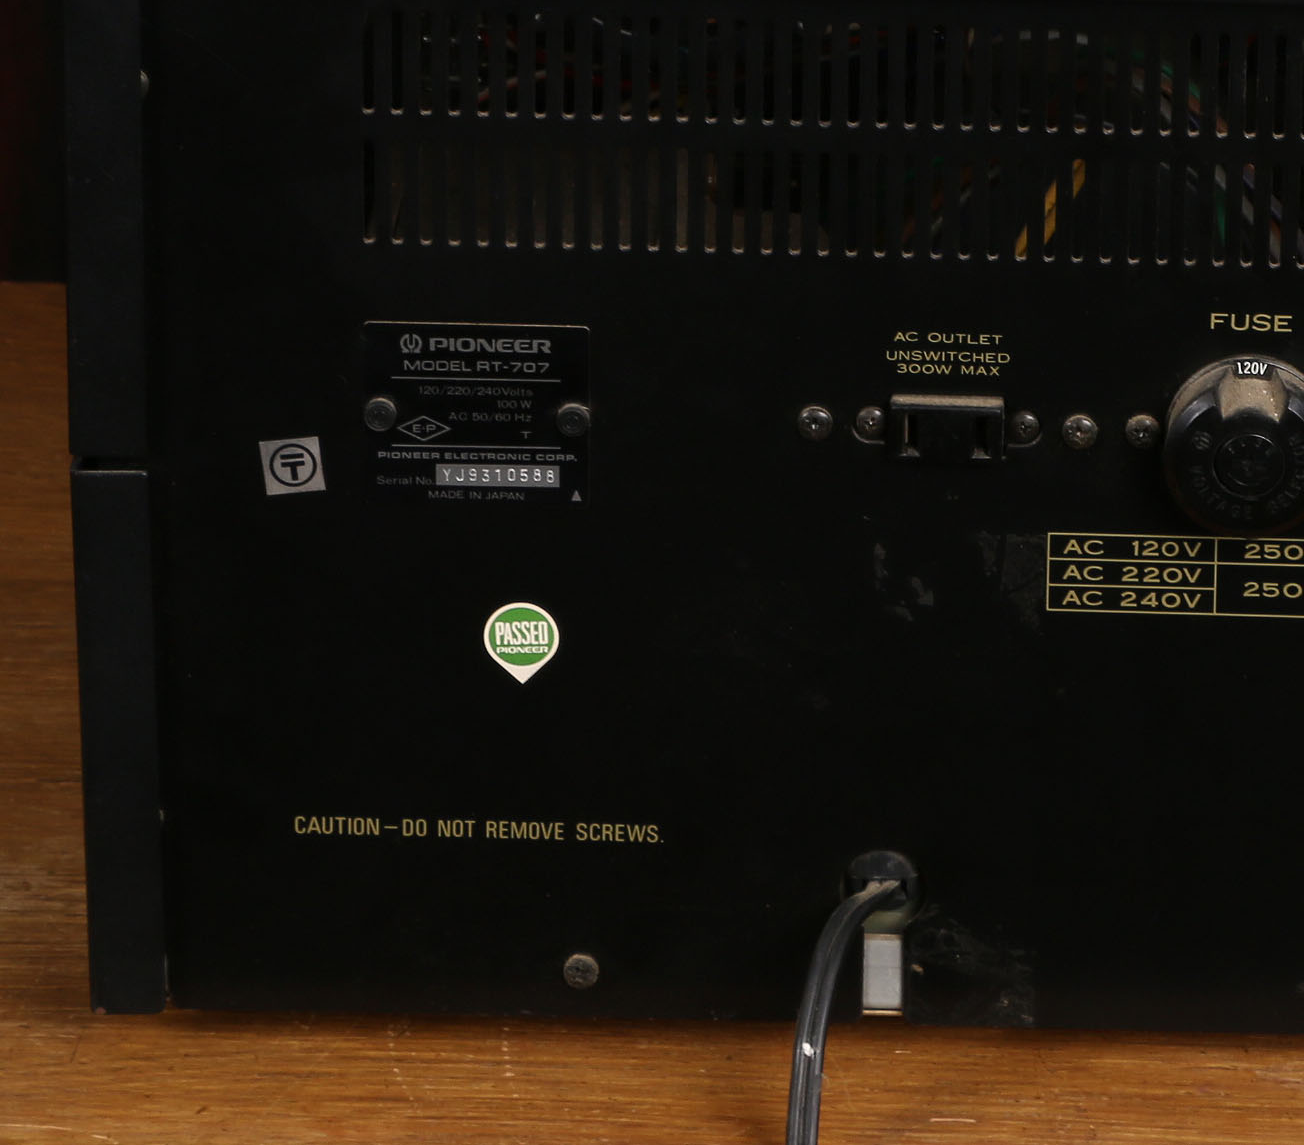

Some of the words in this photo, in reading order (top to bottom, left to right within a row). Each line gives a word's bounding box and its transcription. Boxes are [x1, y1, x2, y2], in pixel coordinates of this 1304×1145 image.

[1210, 313, 1293, 334] FUSE
[429, 337, 552, 354] PIONEER
[893, 331, 920, 344] AC
[927, 332, 1004, 346] OUTLET
[885, 351, 1011, 365] UNSWITCHED
[403, 359, 472, 372] MODEL
[476, 361, 550, 374] RT-707
[896, 363, 955, 376] 300W
[960, 364, 1001, 377] MAX
[1236, 361, 1268, 376] 120V
[448, 412, 469, 422] AC
[472, 413, 512, 422] 50/60
[377, 451, 441, 460] PIONEER
[444, 452, 531, 462] ELECTRONIC
[535, 453, 578, 463] CORP.
[376, 475, 413, 486] Serial
[441, 467, 556, 483] YJ9310588
[427, 489, 464, 500] MADE
[468, 490, 481, 500] IN
[484, 490, 525, 501] JAPAN
[1062, 539, 1105, 556] AC
[1130, 540, 1202, 558] 120V
[1062, 565, 1105, 581] AC
[1120, 566, 1203, 584] 220V
[1062, 590, 1105, 607] AC
[1119, 592, 1202, 610] 240V
[495, 620, 549, 646] PASSED
[496, 646, 549, 654] PIONEER
[437, 819, 476, 840] NOT
[485, 820, 565, 841] REMOVE
[575, 823, 665, 844] SCREWS.
